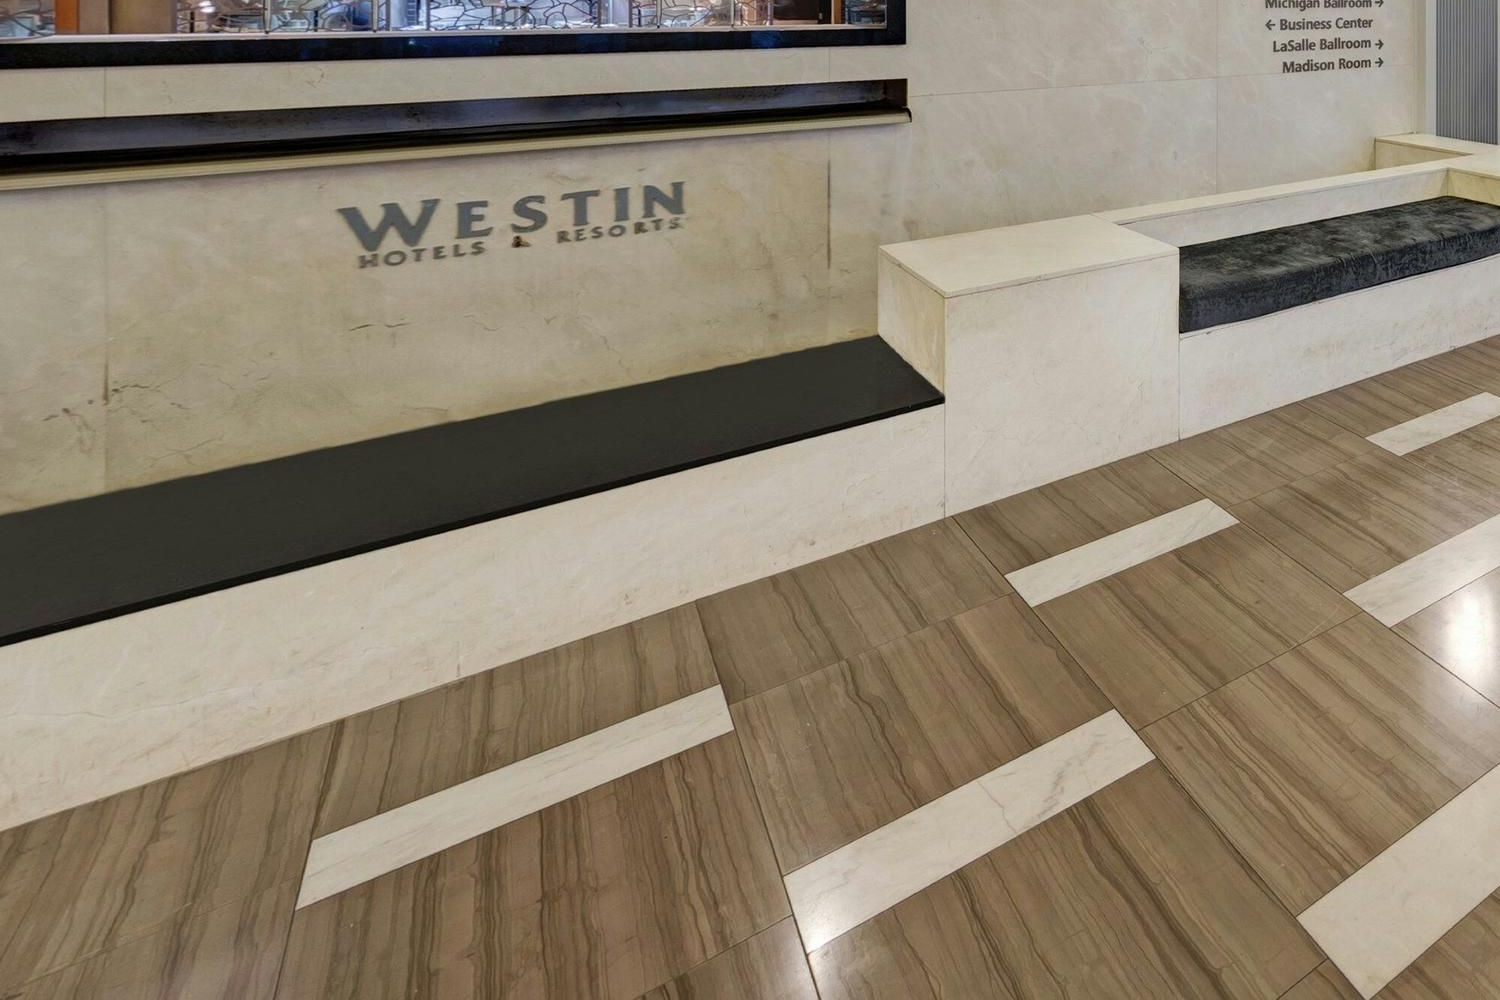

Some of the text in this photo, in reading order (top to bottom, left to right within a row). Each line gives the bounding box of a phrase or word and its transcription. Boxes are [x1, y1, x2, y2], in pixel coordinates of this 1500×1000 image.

[1279, 17, 1373, 31] Business Center
[1272, 37, 1372, 53] LaSalle Ballroom
[1282, 57, 1372, 74] Madison Room
[336, 181, 687, 252] WESTIN
[357, 241, 487, 269] HOTELS
[556, 217, 683, 244] RESORTS
